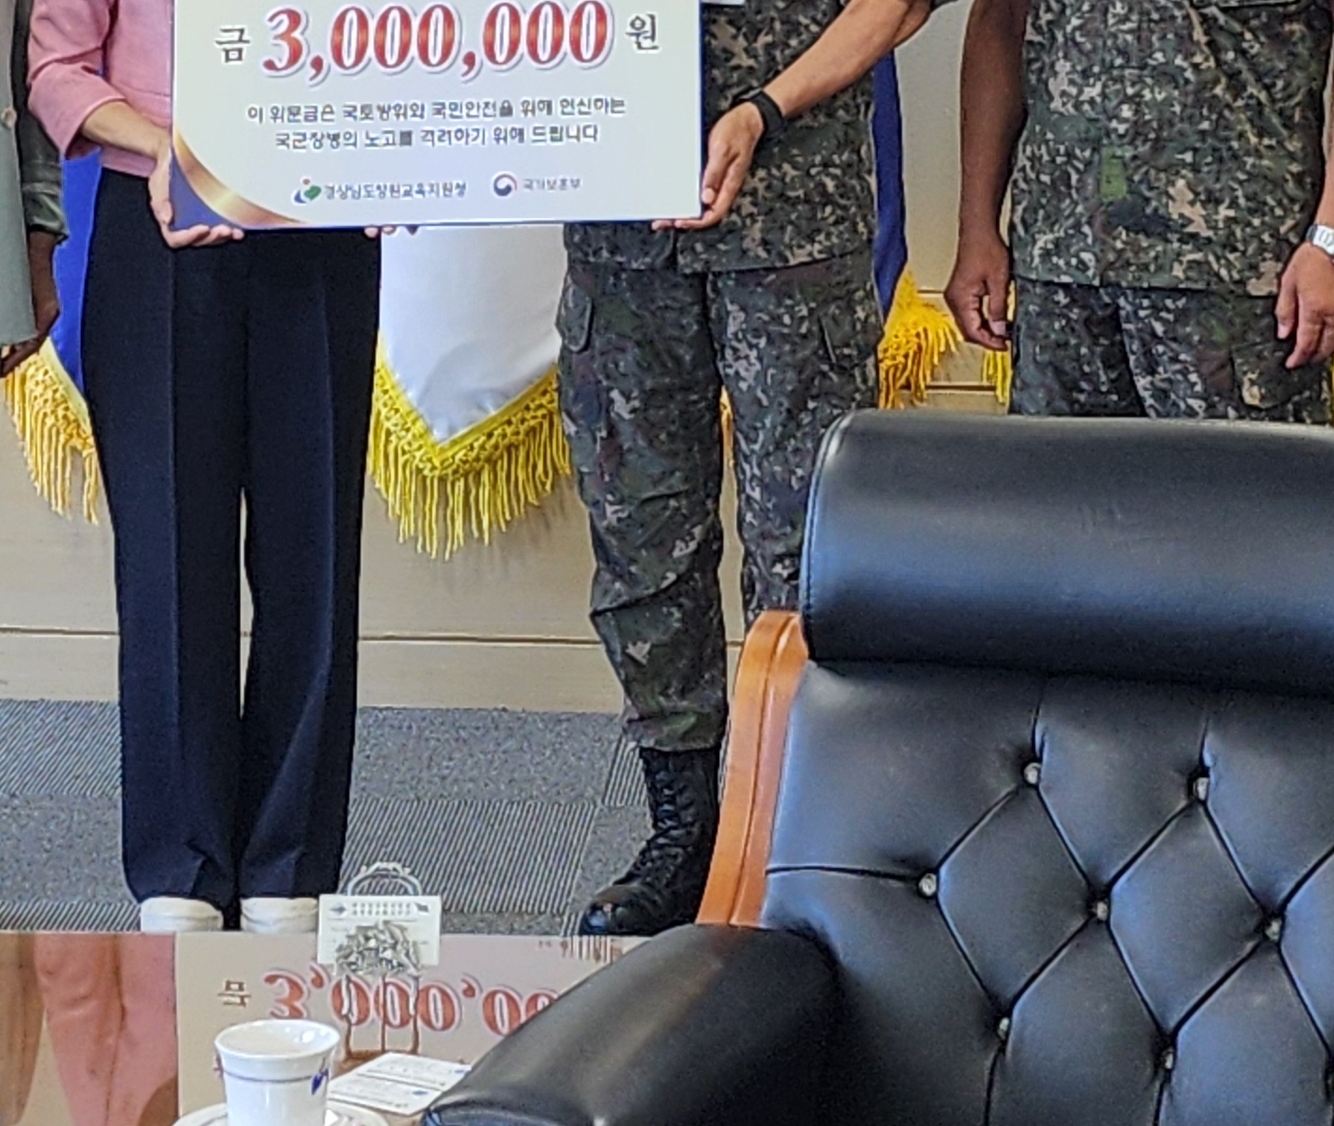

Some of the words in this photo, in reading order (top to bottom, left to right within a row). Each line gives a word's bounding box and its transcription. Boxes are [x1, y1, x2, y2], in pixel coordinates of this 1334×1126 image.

[214, 26, 251, 63] 금
[262, 0, 612, 80] 3,000,000
[626, 13, 662, 51] 원
[247, 104, 264, 124] 이
[520, 98, 554, 117] 위해
[493, 126, 525, 145] 위해
[530, 124, 599, 143] 드립니다
